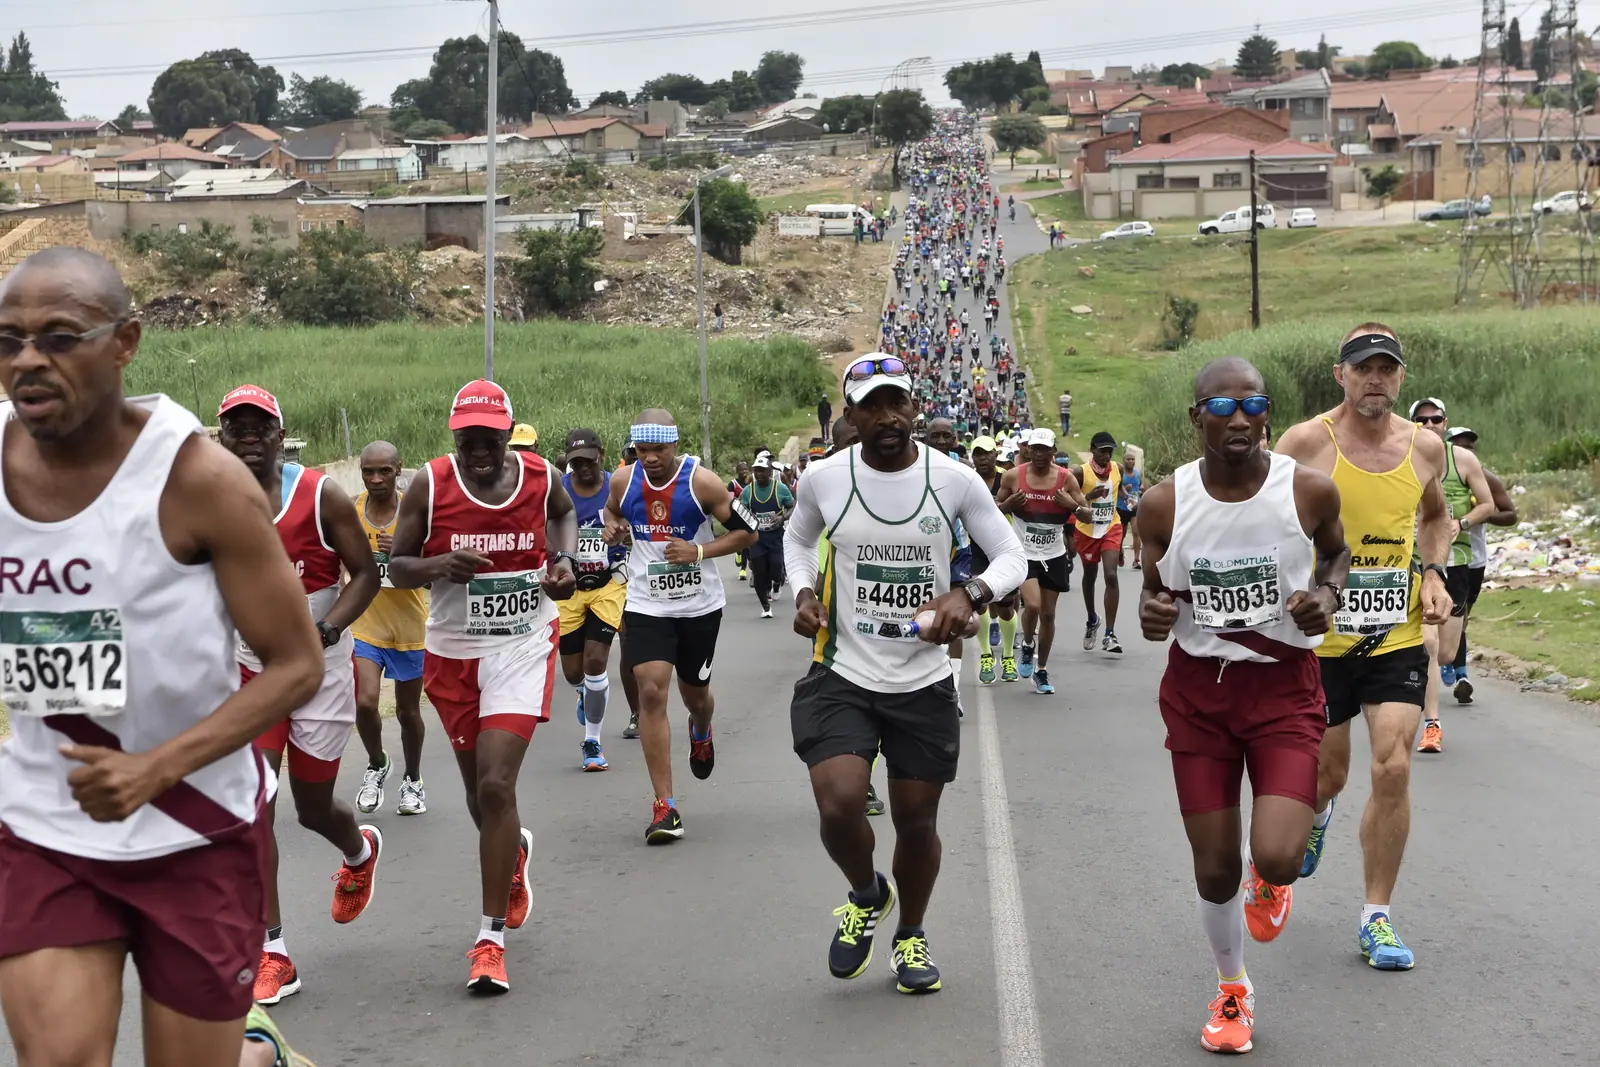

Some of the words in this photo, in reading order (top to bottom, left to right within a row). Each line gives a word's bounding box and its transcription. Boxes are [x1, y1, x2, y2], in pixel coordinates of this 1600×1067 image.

[451, 533, 515, 552] CHEETAHS
[517, 532, 535, 550] AC
[1030, 534, 1056, 544] 46805
[857, 545, 932, 561] ZONKIZIZWE
[1214, 556, 1275, 569] OLDMUTUAL
[0, 557, 92, 596] RAC
[650, 580, 657, 588] C
[659, 571, 702, 590] 50545
[918, 566, 935, 578] 42
[1258, 565, 1276, 577] 42
[1393, 572, 1406, 583] 42
[471, 602, 480, 613] B
[483, 589, 540, 617] 52065
[858, 586, 867, 600] B
[869, 583, 934, 608] 44885
[1197, 592, 1208, 606] D
[1210, 580, 1280, 613] 50835
[1348, 589, 1405, 612] 50563
[91, 610, 122, 631] 42
[871, 610, 889, 619] Craig
[857, 622, 874, 634] CGA
[4, 659, 13, 685] B
[15, 643, 122, 693] 56212
